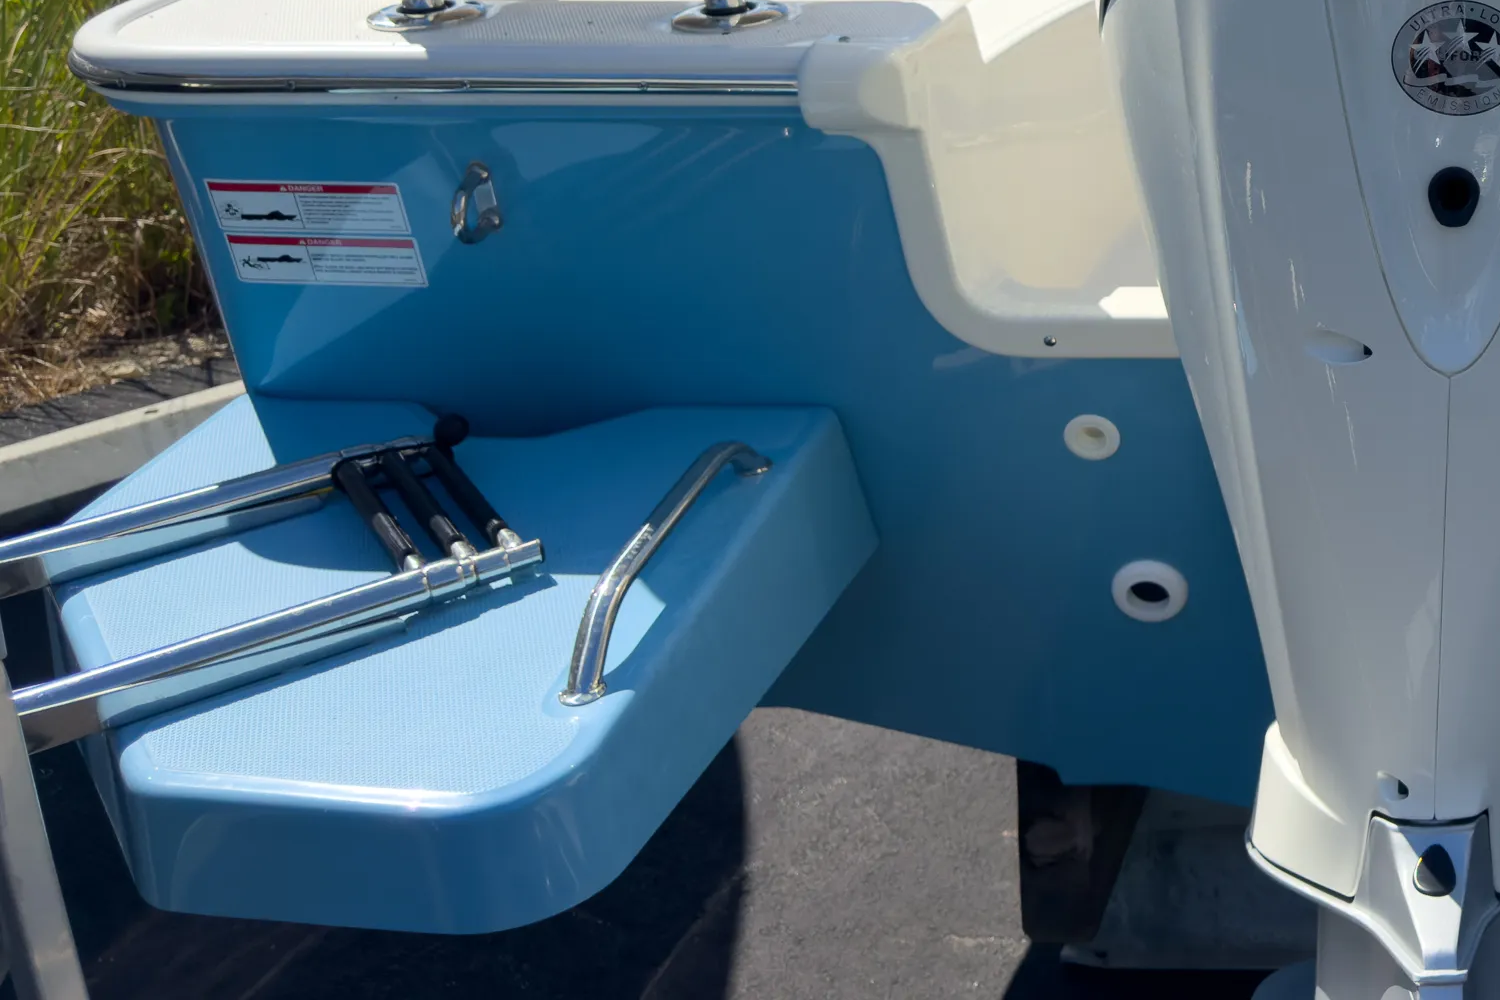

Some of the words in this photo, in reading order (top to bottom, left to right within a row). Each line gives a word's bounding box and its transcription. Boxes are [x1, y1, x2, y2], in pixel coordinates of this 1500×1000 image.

[1410, 5, 1464, 31] ULTRA
[287, 185, 324, 193] DANGER
[307, 238, 342, 246] DANGER
